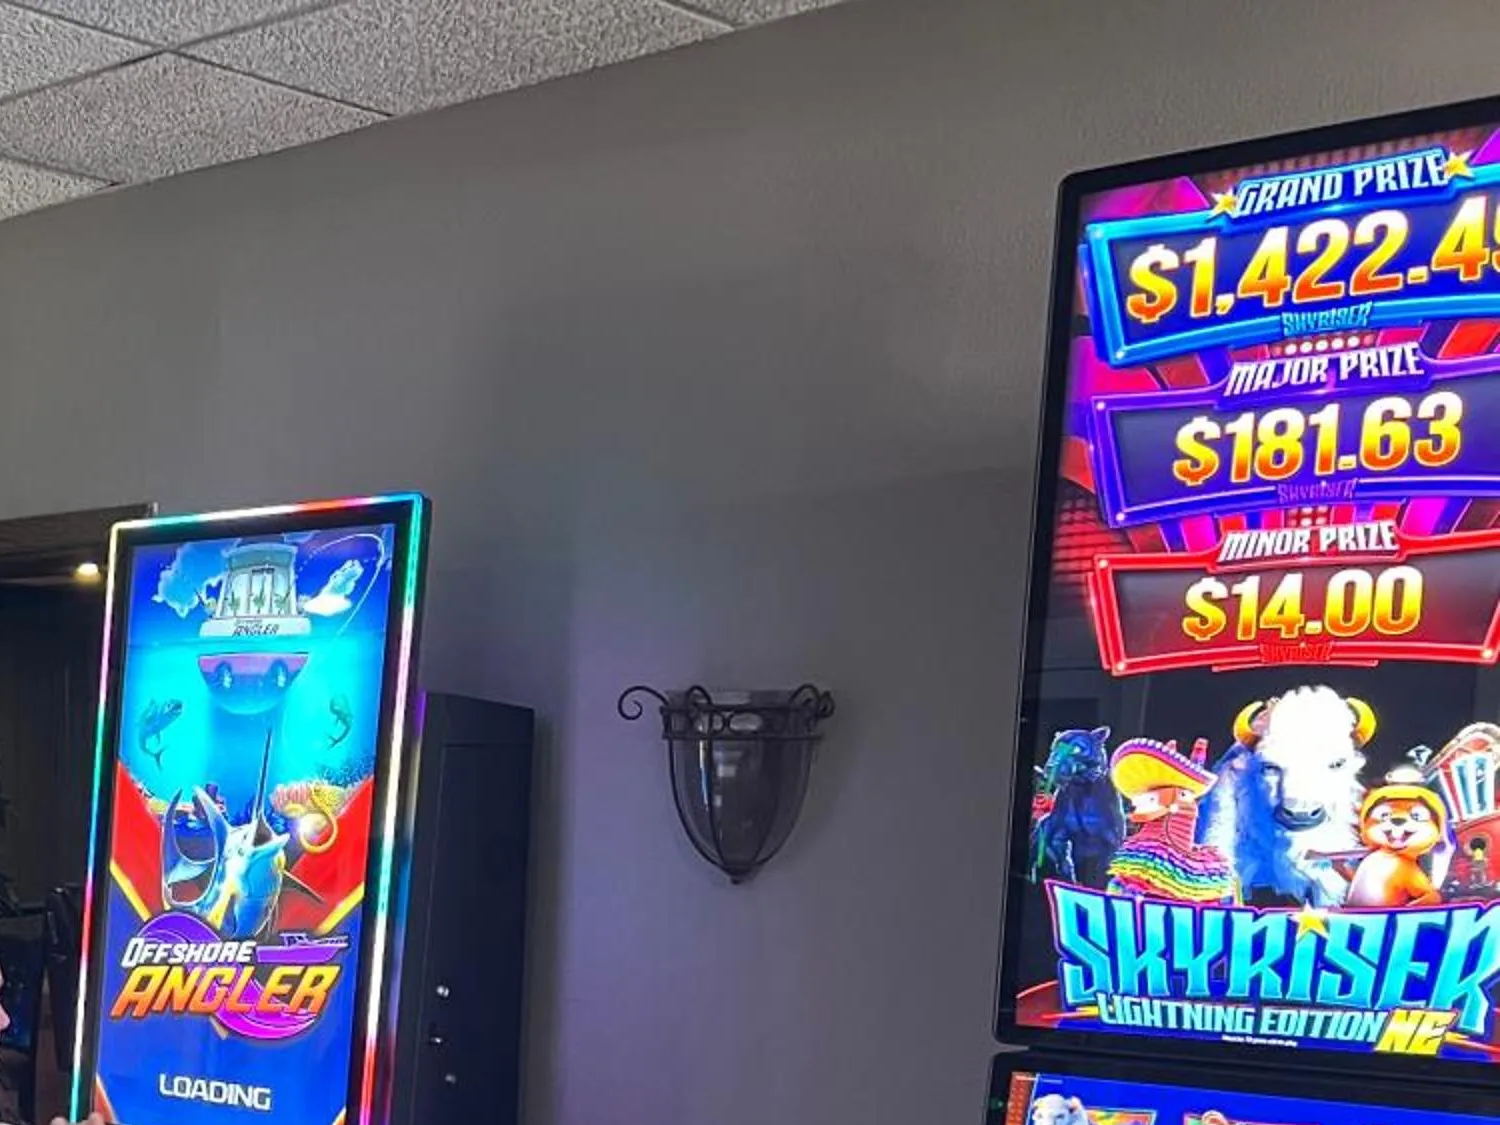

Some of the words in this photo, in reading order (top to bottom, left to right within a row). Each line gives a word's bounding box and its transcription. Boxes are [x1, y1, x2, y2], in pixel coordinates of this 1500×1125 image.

[1232, 172, 1343, 218] GRAND
[1353, 151, 1448, 197] PRIZE
[1126, 194, 1500, 322] $1,422.4
[1224, 356, 1329, 396] MAJOR
[1339, 342, 1425, 380] PRIZE
[1173, 391, 1463, 487] $181.63
[1217, 528, 1311, 563] MINOR
[1319, 520, 1399, 554] PRIZE
[1182, 566, 1423, 642] $14.00
[121, 937, 257, 968] OFFSHORE
[1054, 884, 1500, 1034] SKYRISER
[110, 965, 341, 1017] ANGLER
[1098, 992, 1256, 1035] LIGHTNING
[1259, 1006, 1389, 1043] EDITION
[158, 1073, 272, 1111] LOADING
